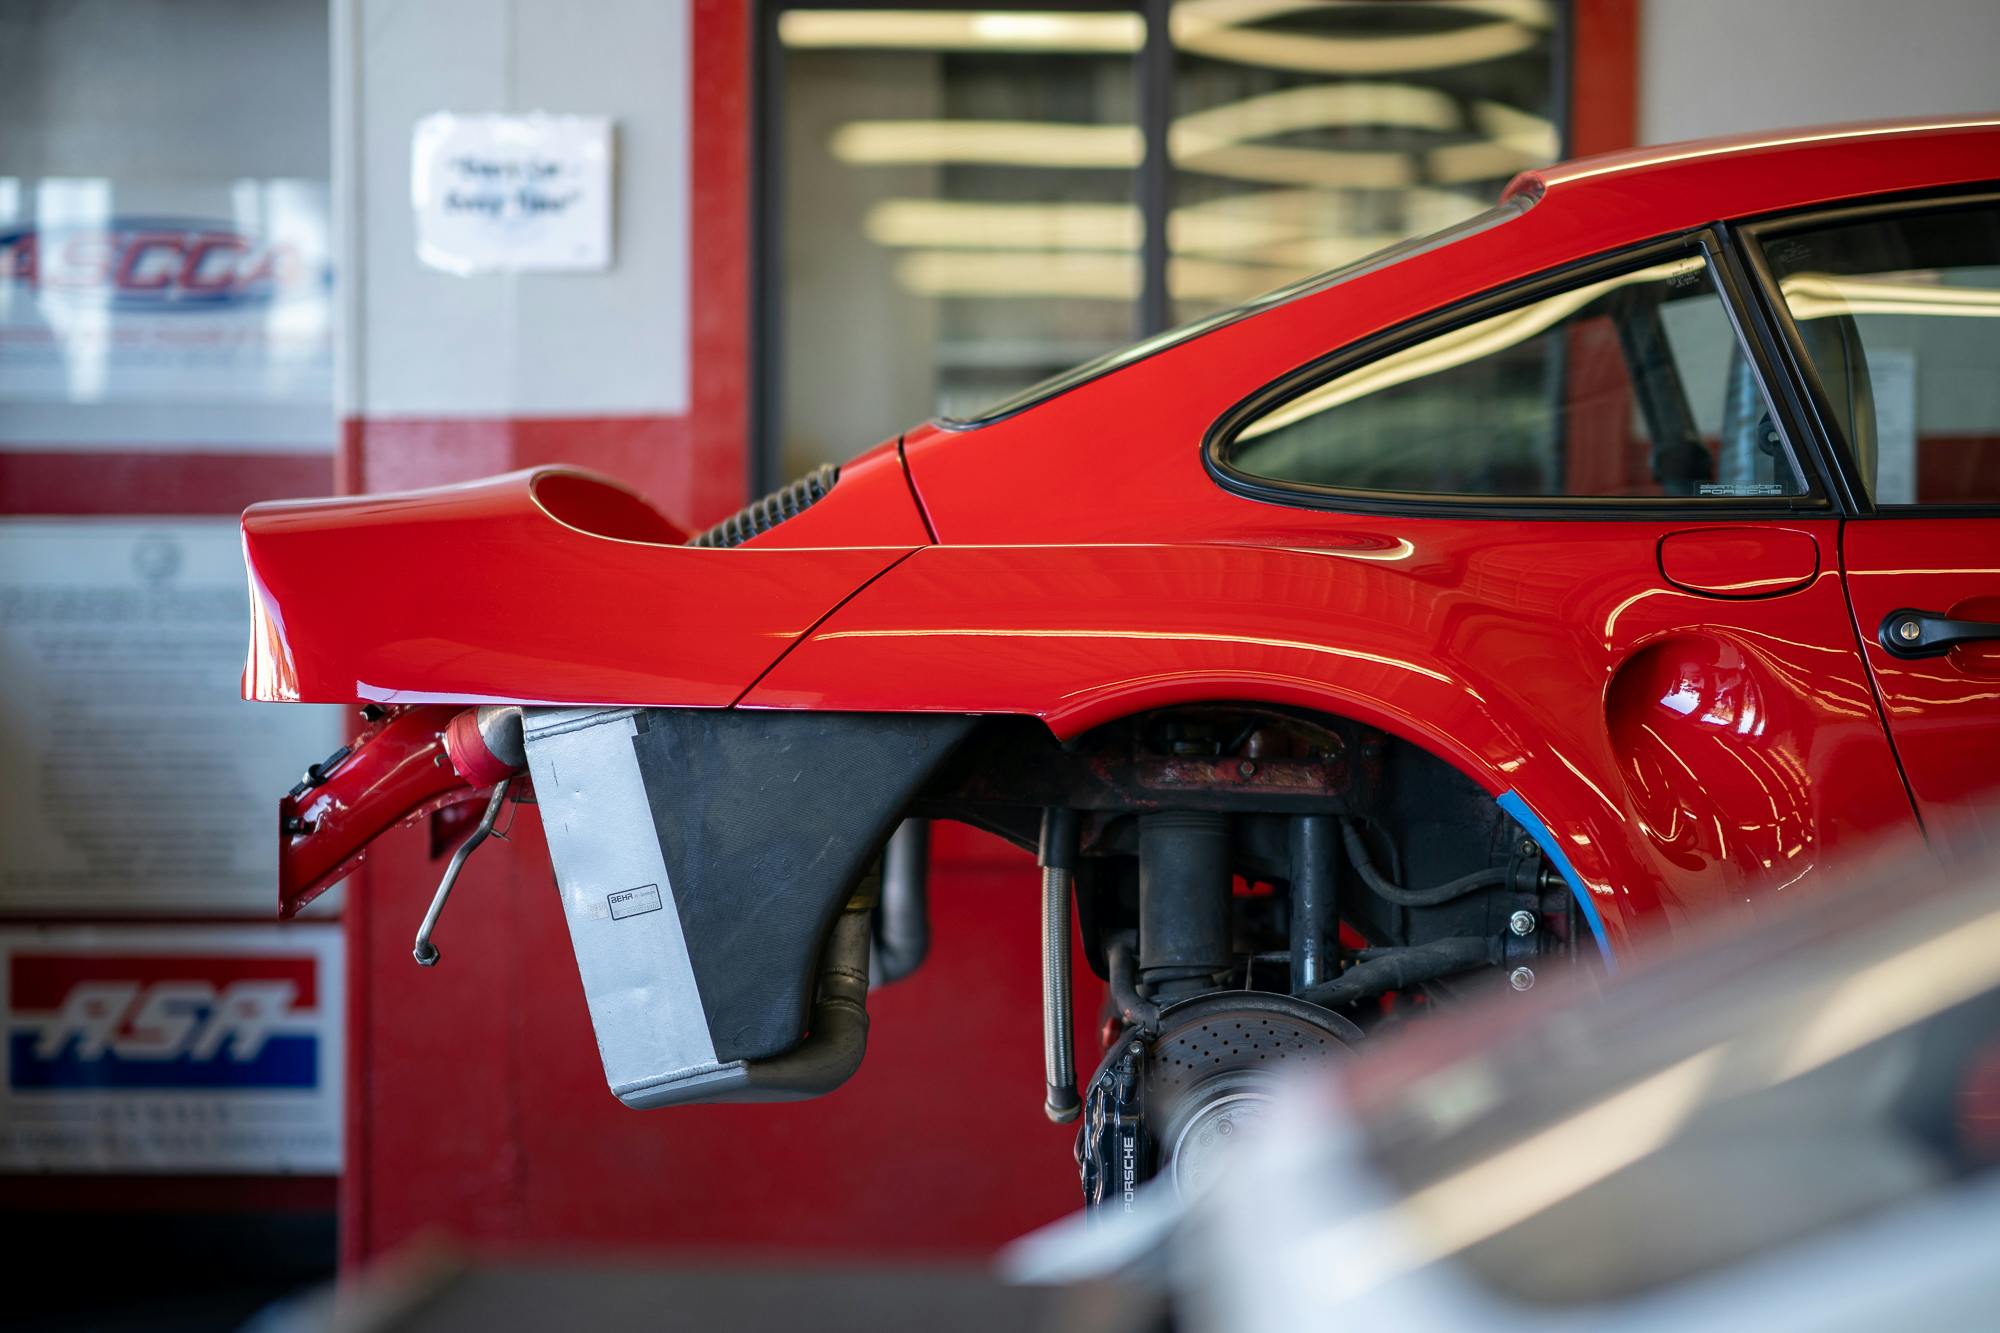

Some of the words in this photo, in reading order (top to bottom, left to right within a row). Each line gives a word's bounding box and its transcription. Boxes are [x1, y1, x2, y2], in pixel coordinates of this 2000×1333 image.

[610, 893, 633, 904] BEHR
[34, 979, 297, 1060] ASA
[1123, 1137, 1134, 1213] PORSCHE
